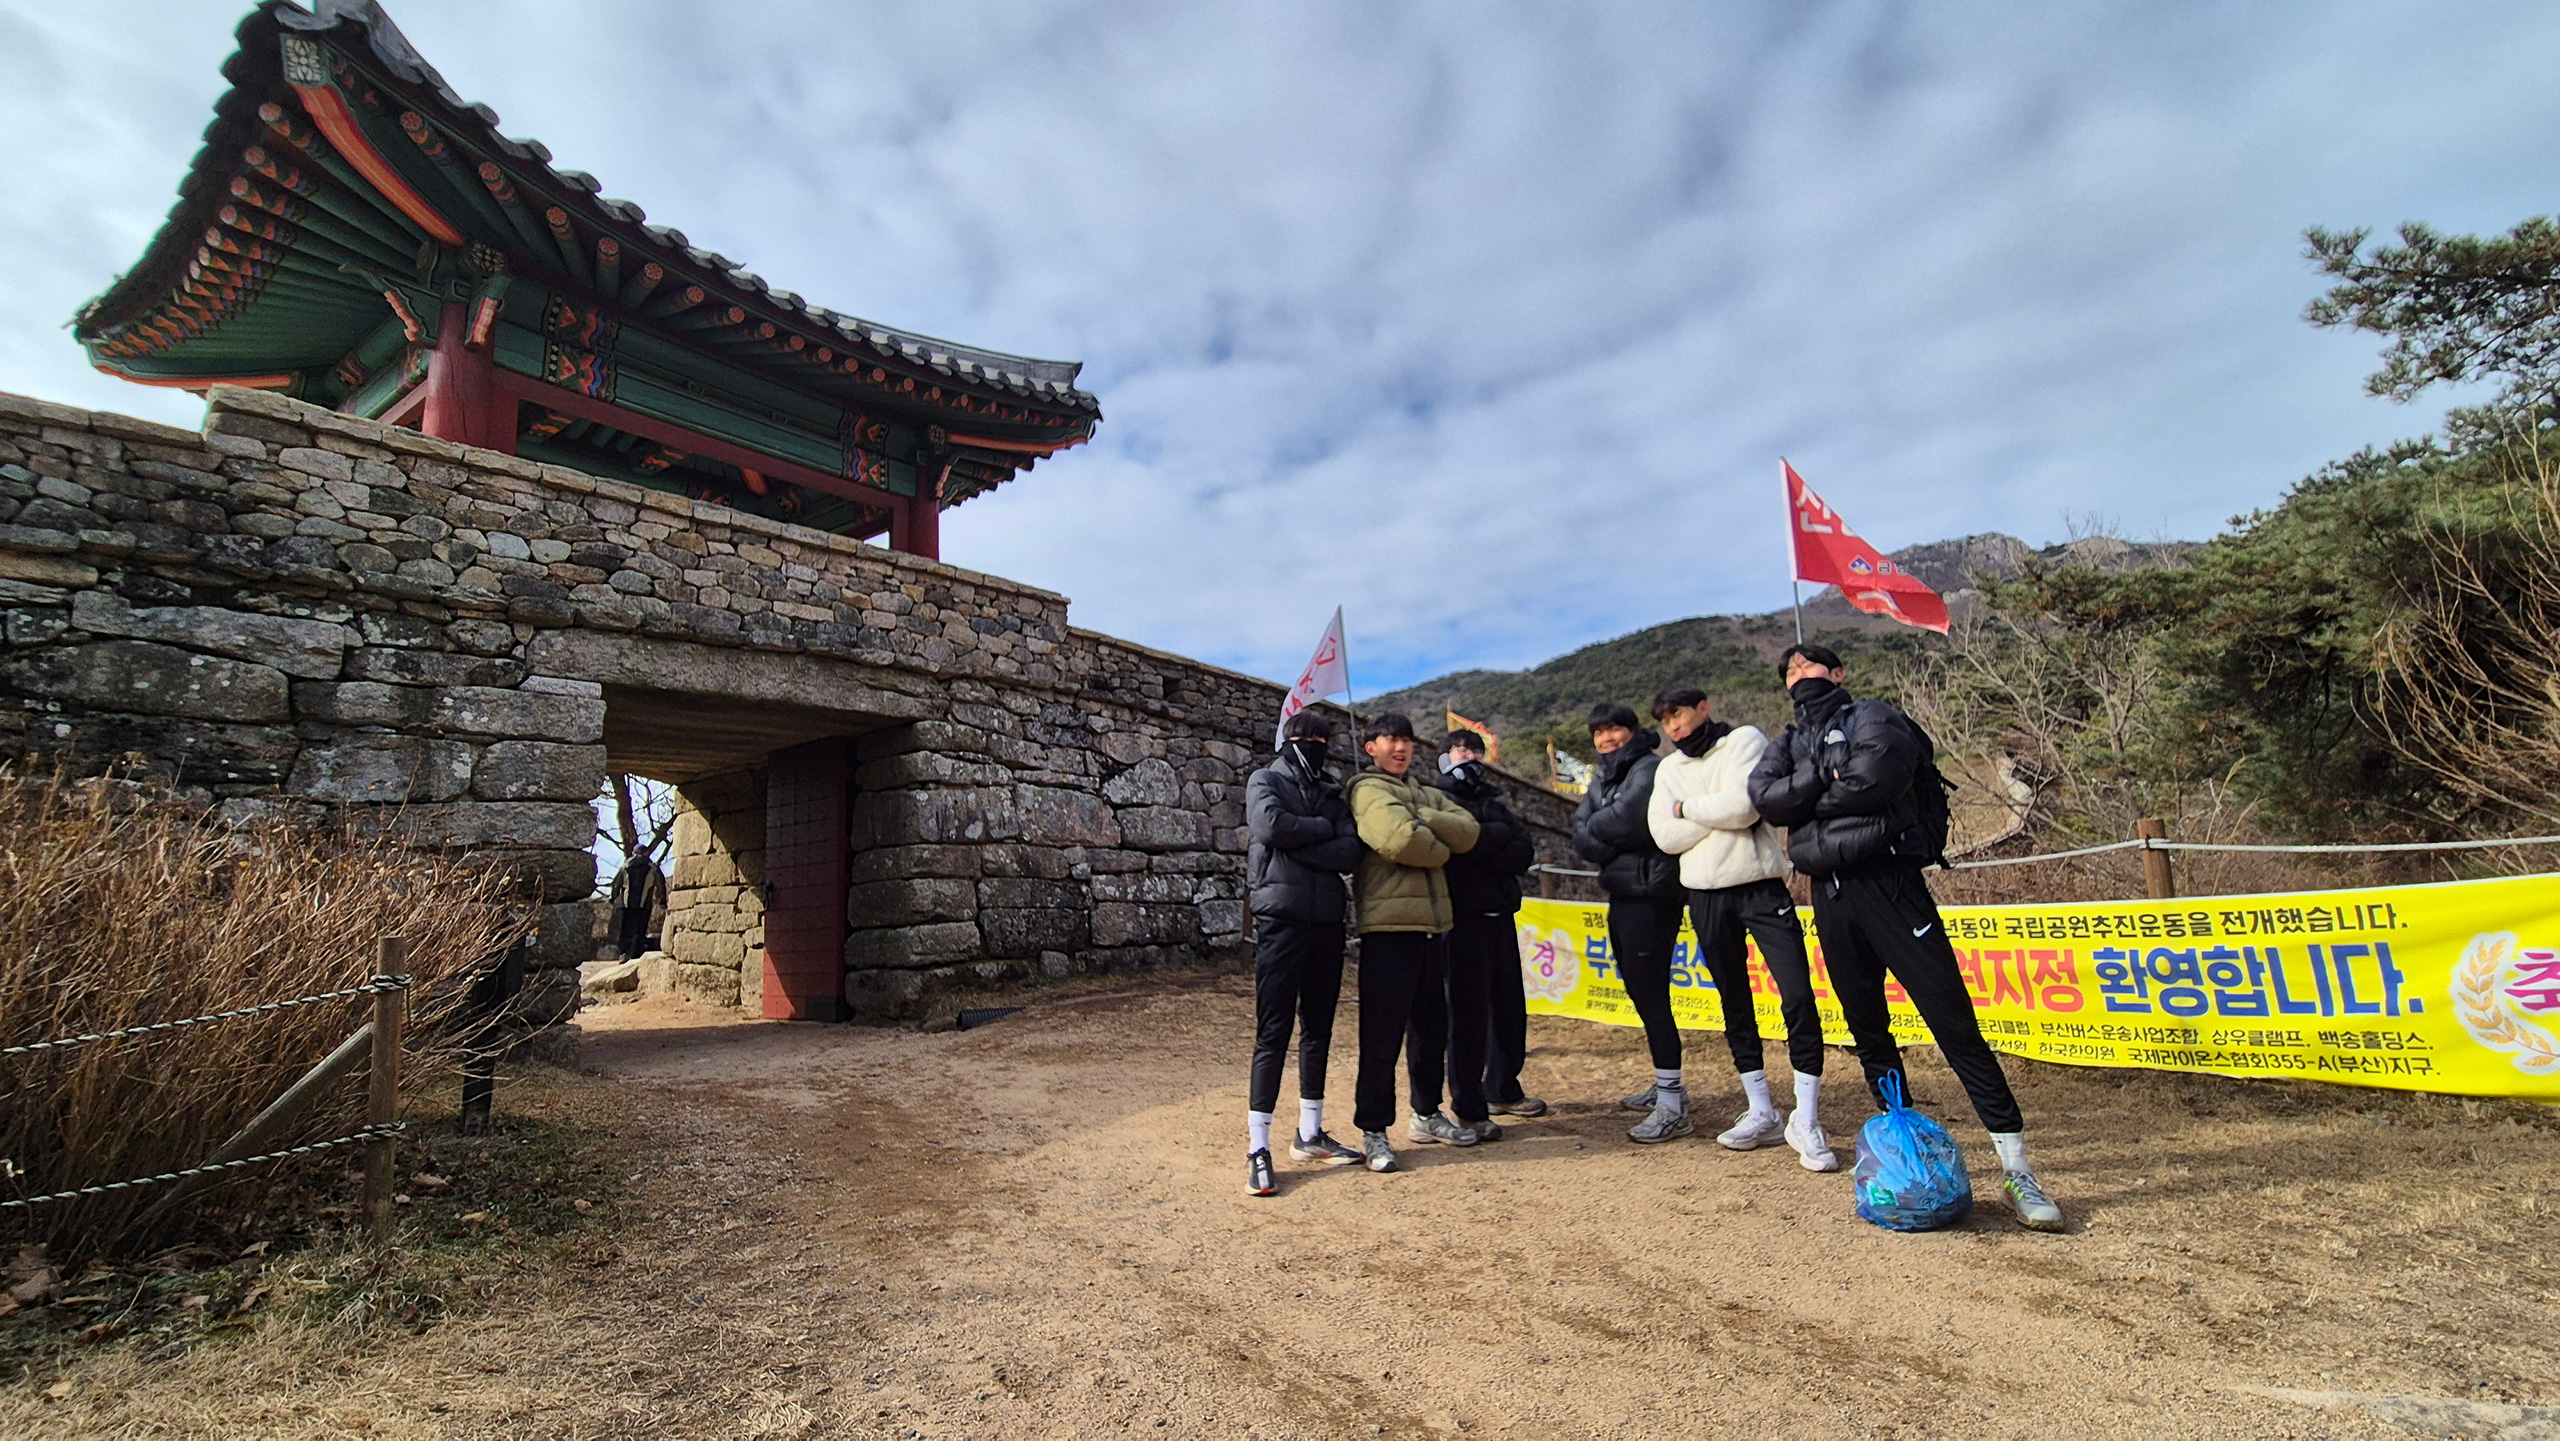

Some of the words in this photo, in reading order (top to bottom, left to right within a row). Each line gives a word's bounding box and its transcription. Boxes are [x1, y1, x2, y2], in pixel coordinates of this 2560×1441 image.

[2005, 911, 2214, 940] 국립공원추진운동을
[2219, 903, 2408, 937] 전개했습니다.
[2092, 942, 2425, 1018] 환영합니다.
[2040, 1021, 2204, 1046] 부산버스운송사업조합.
[2127, 1047, 2442, 1077] 국제라이온스협회355-A(부산)지구.
